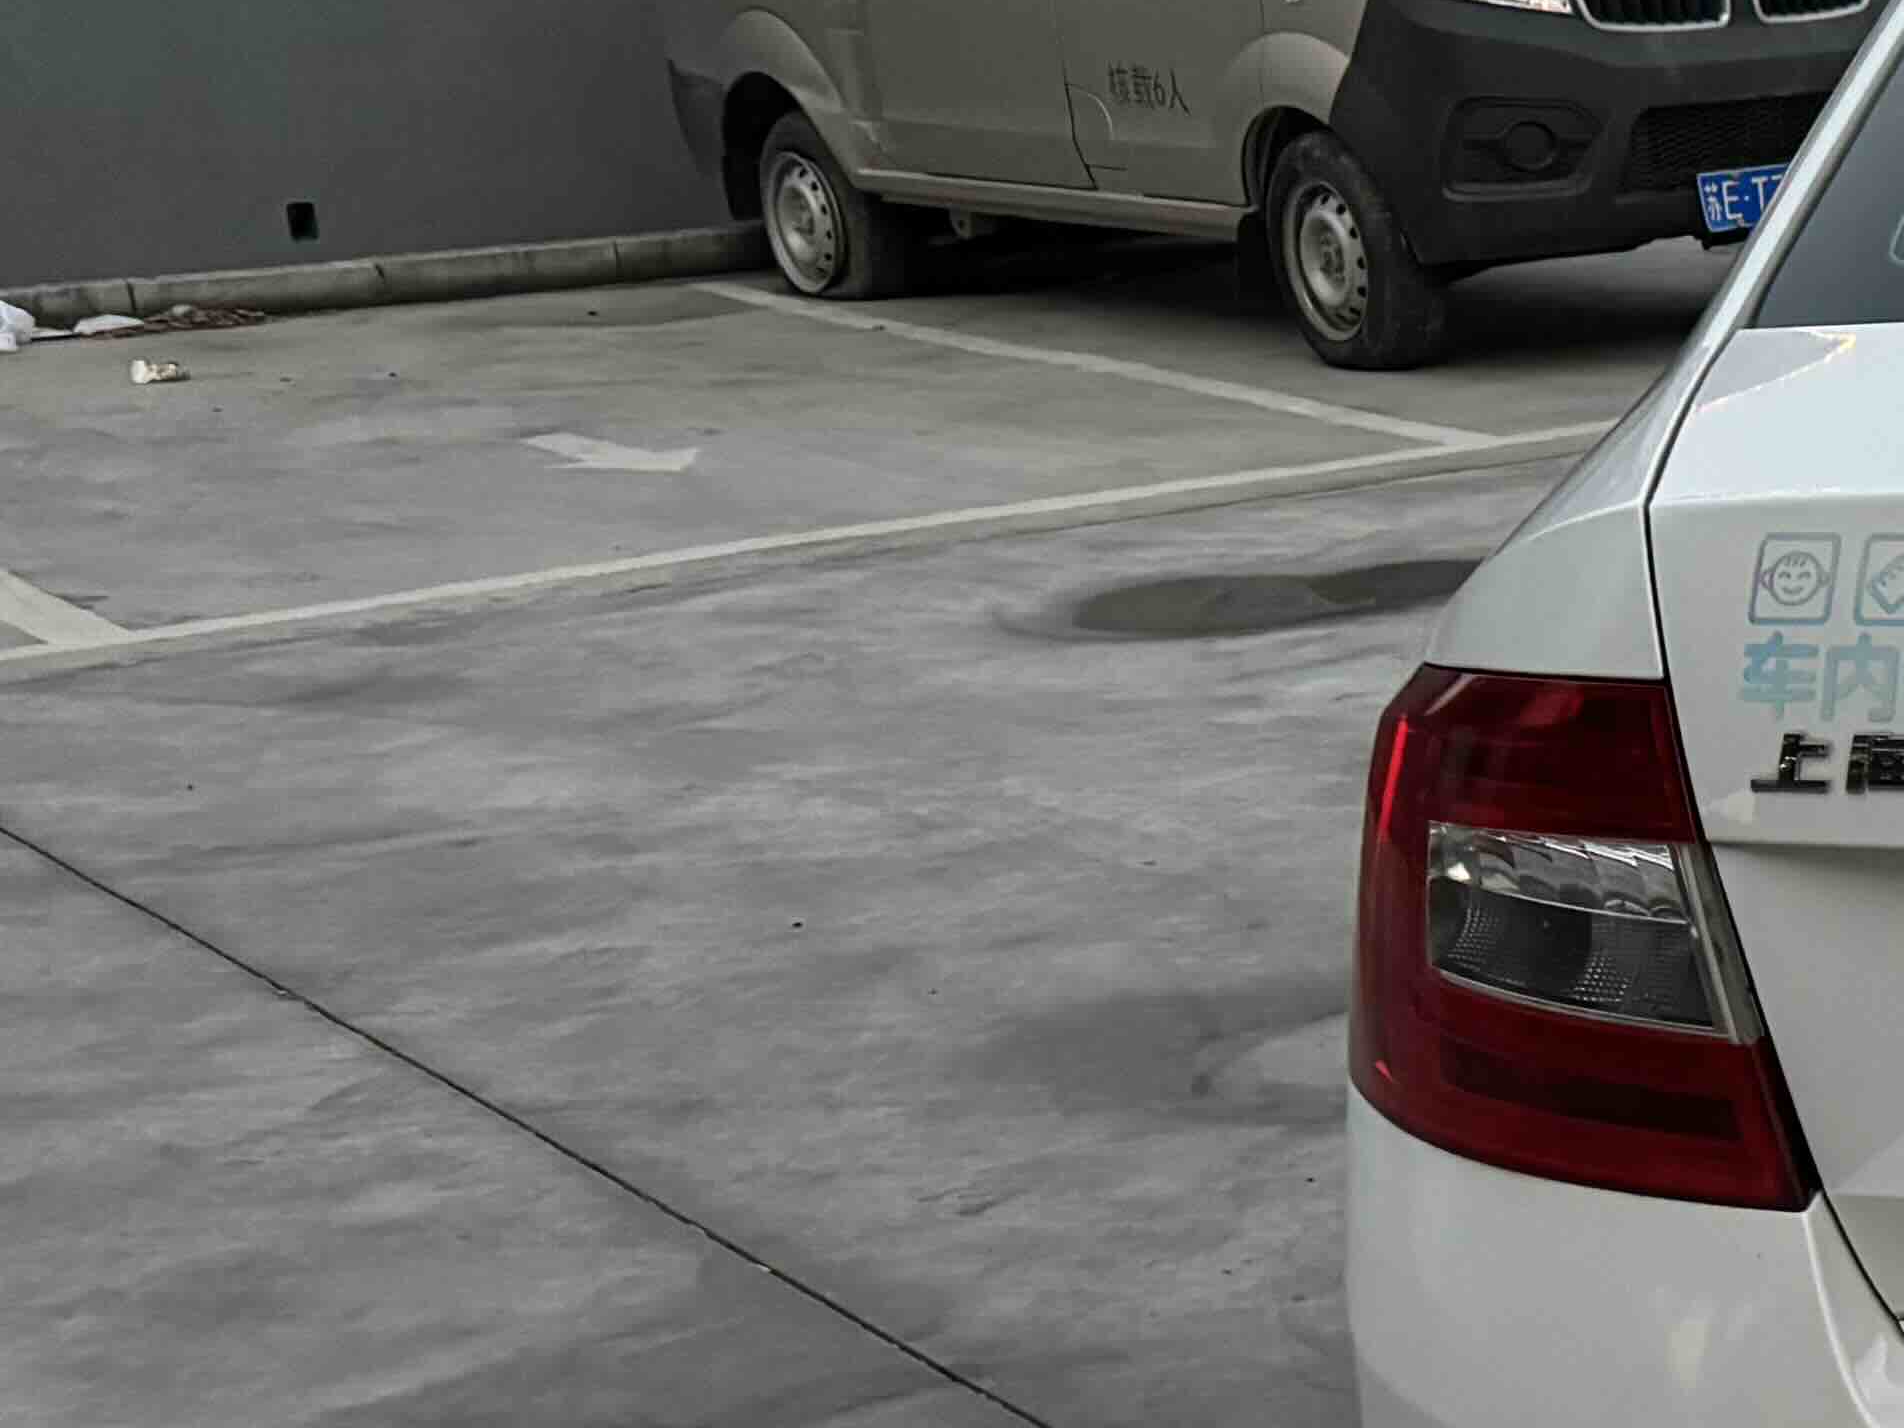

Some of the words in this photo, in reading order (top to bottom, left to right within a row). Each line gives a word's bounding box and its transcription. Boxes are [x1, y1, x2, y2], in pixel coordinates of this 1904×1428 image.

[1106, 60, 1191, 115] 核载6人
[1703, 174, 1782, 221] 苏E·T
